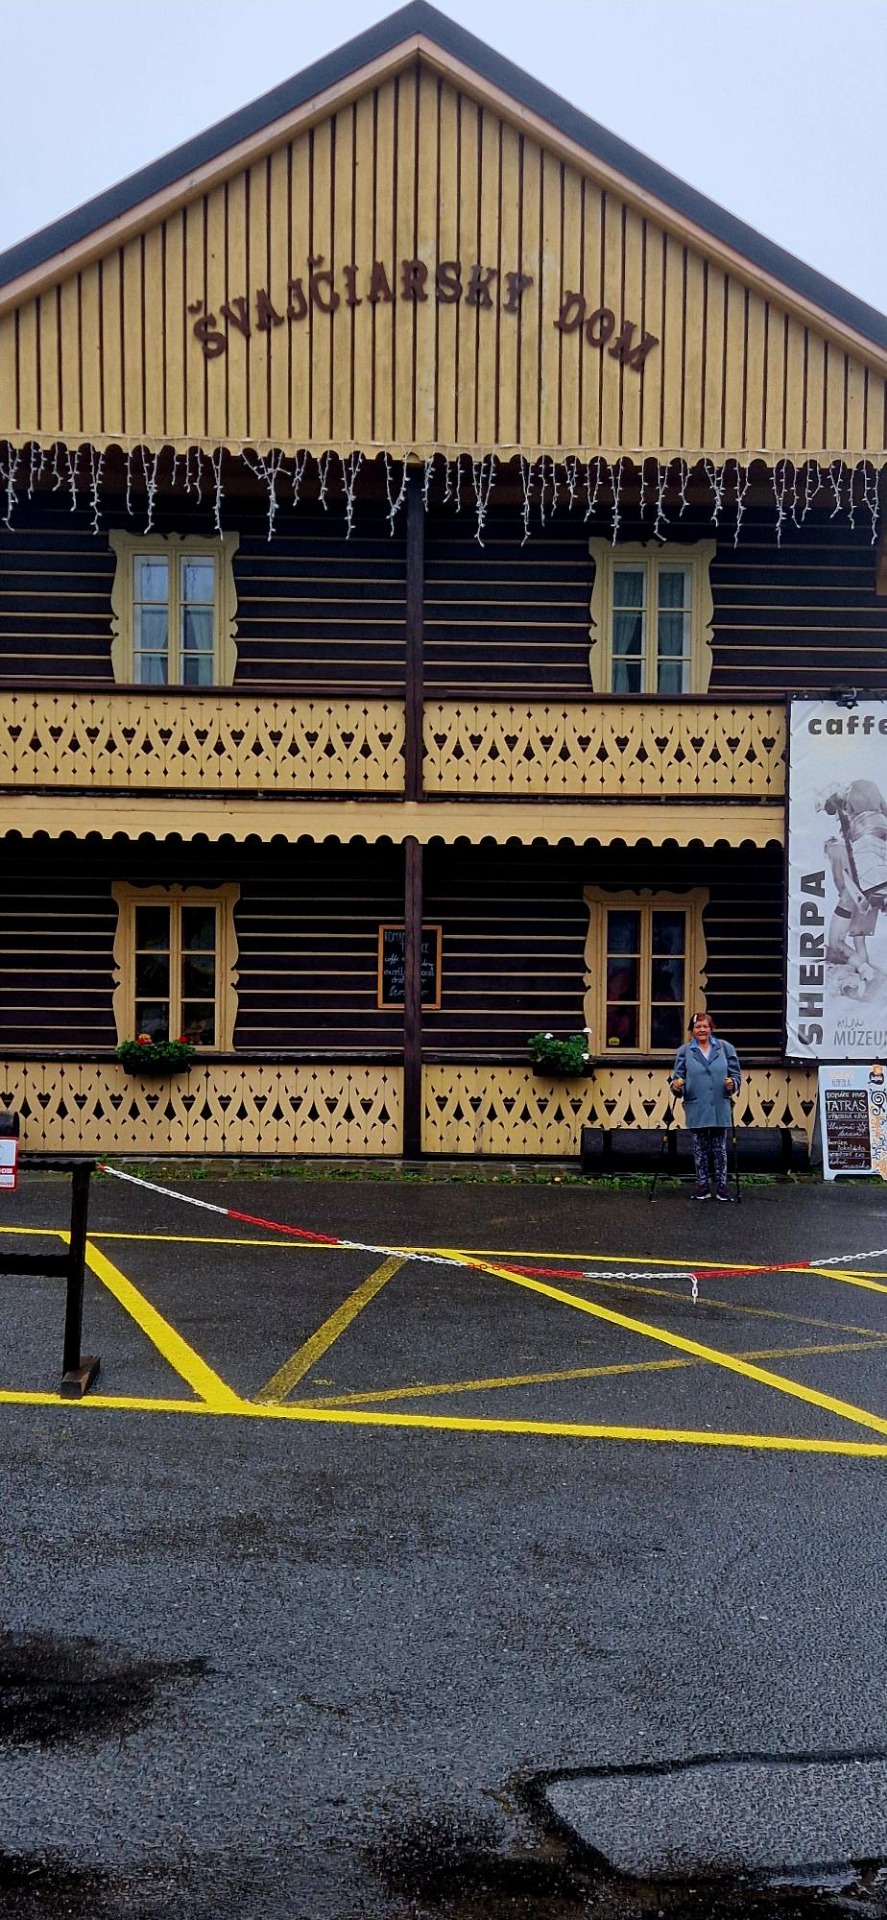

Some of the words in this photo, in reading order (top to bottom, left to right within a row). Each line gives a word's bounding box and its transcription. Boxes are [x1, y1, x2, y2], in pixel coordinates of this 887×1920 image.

[189, 254, 533, 359] ŠVAJČIARSKY
[552, 290, 659, 373] DOM
[798, 870, 826, 1046] SHERPA
[834, 1027, 887, 1046] MÚZEU
[826, 1100, 866, 1112] TATRAS
